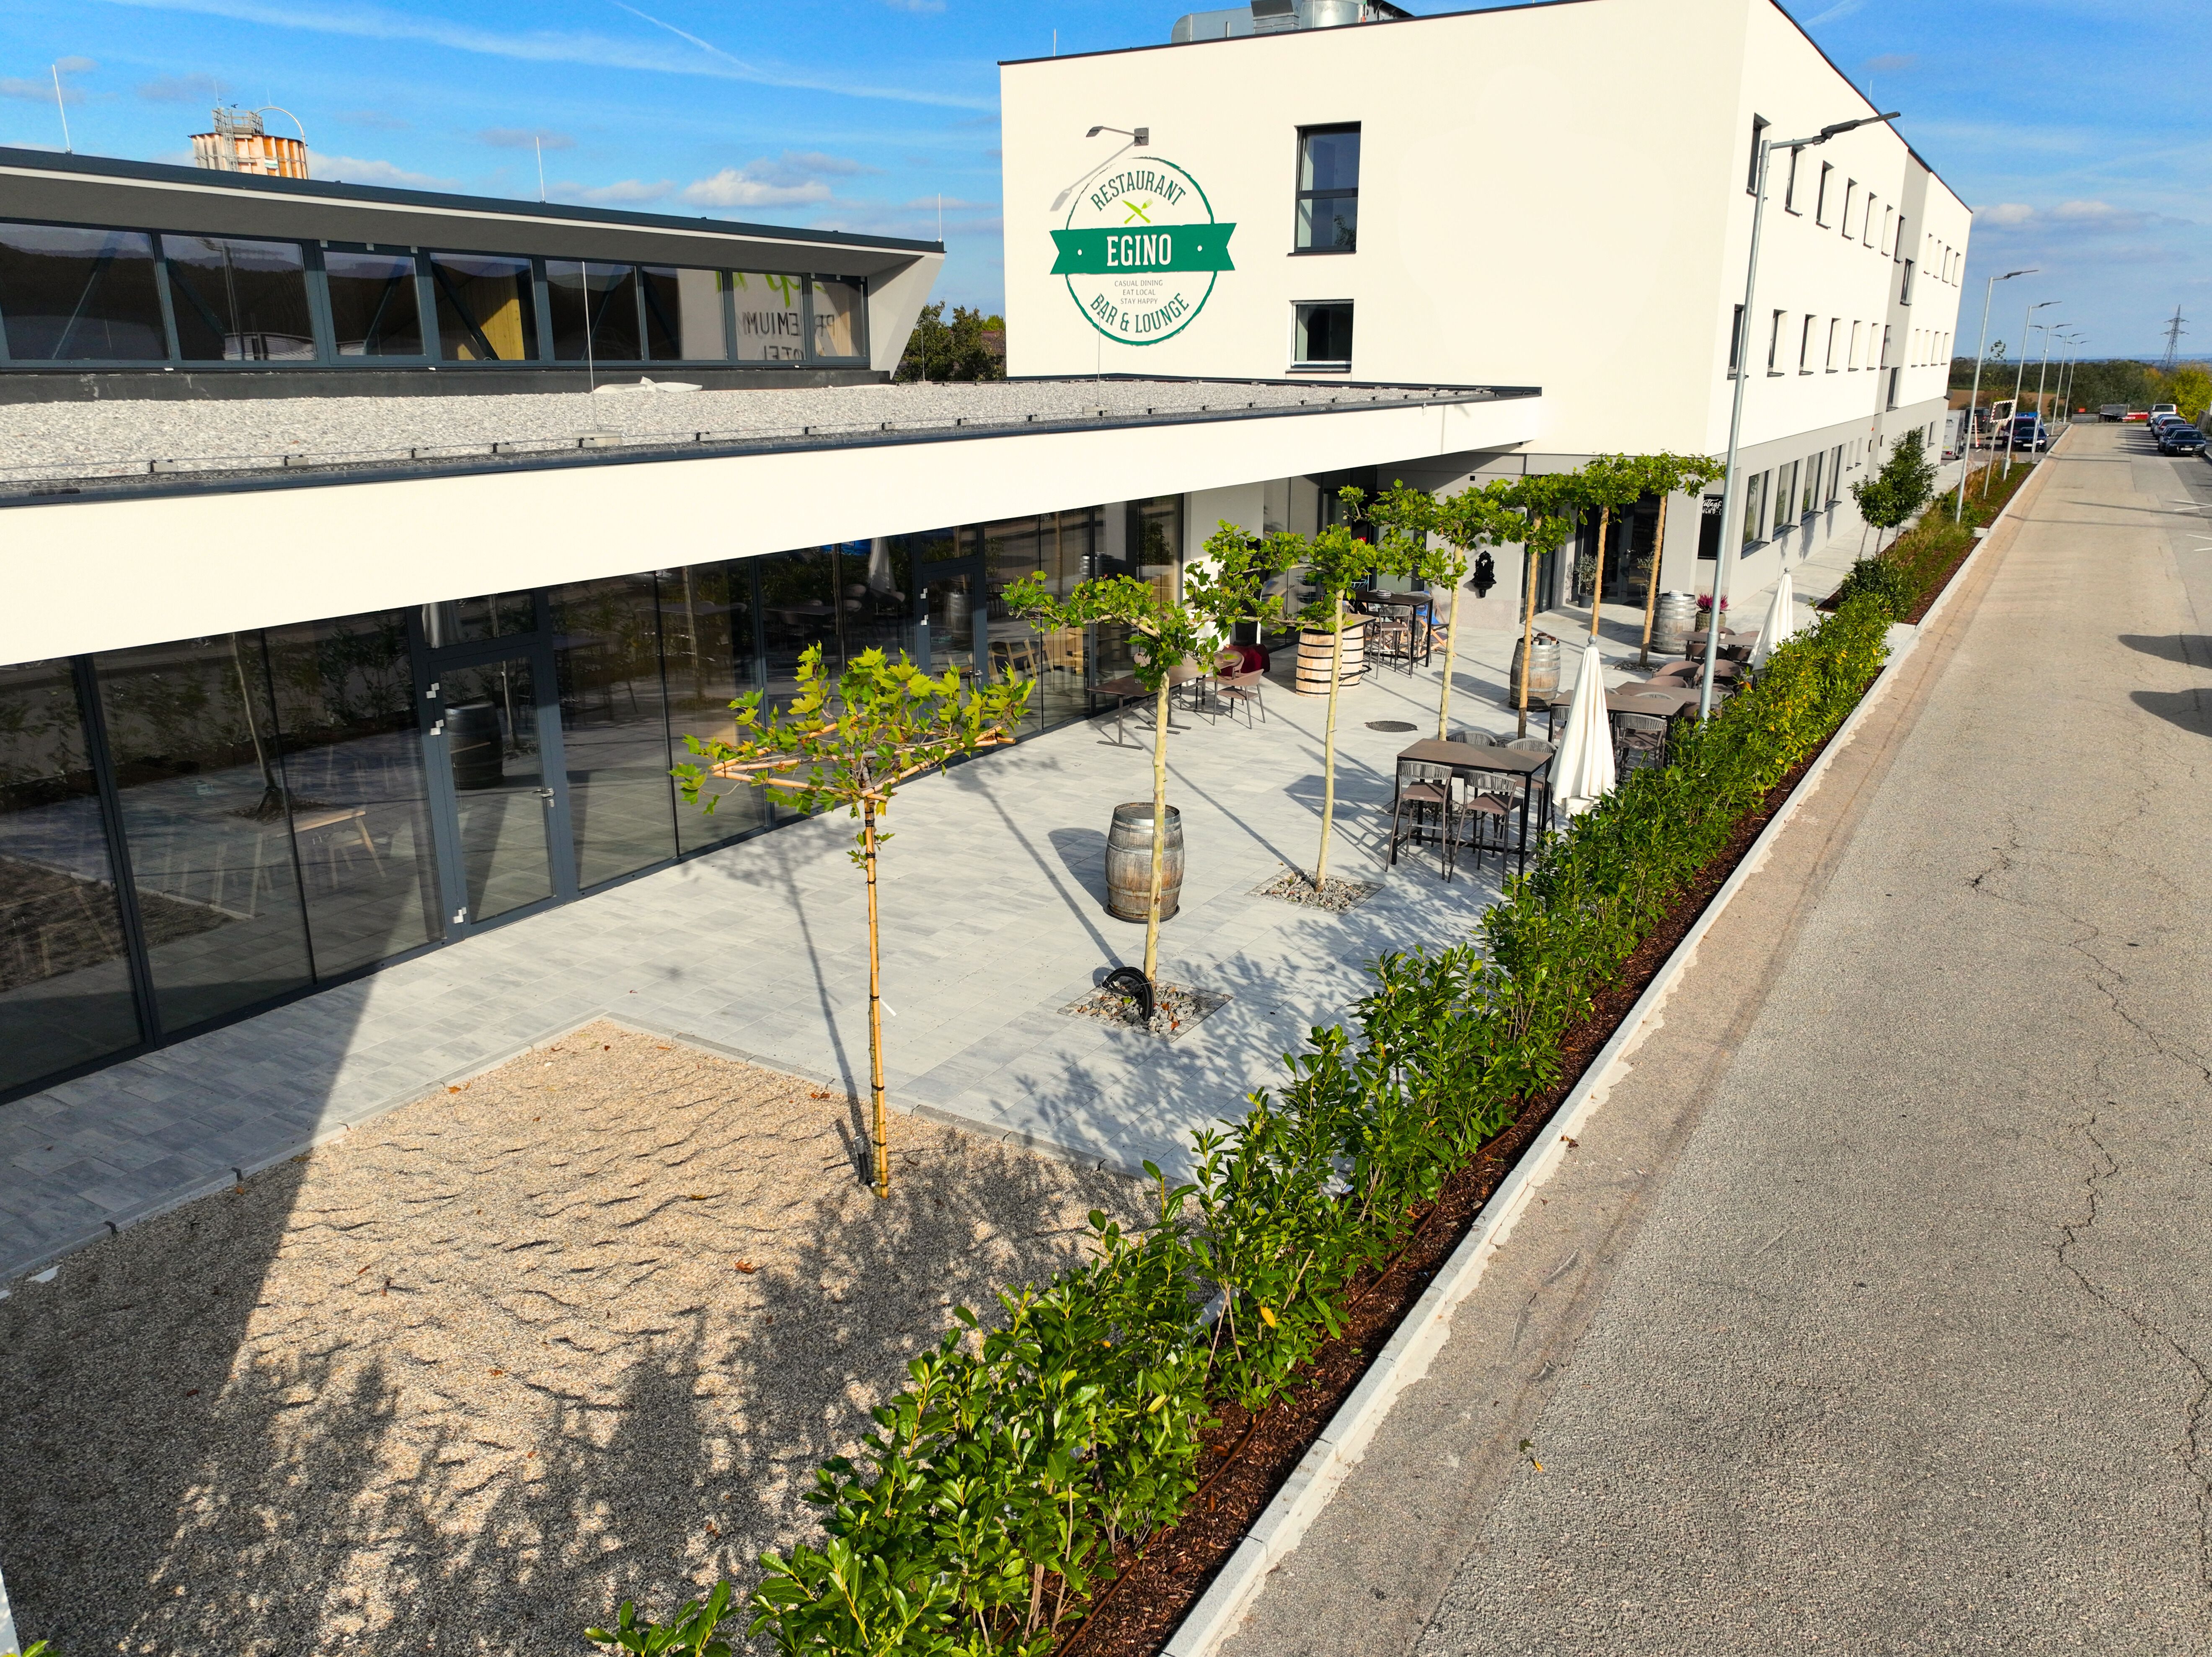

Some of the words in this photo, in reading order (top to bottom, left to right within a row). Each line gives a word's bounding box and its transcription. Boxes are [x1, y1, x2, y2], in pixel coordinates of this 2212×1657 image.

[1090, 170, 1186, 212] RESTAURANT
[1107, 234, 1172, 266] EGINO
[1090, 293, 1118, 326] BAR
[1120, 312, 1130, 332] &
[1135, 292, 1190, 333] LOUNGE
